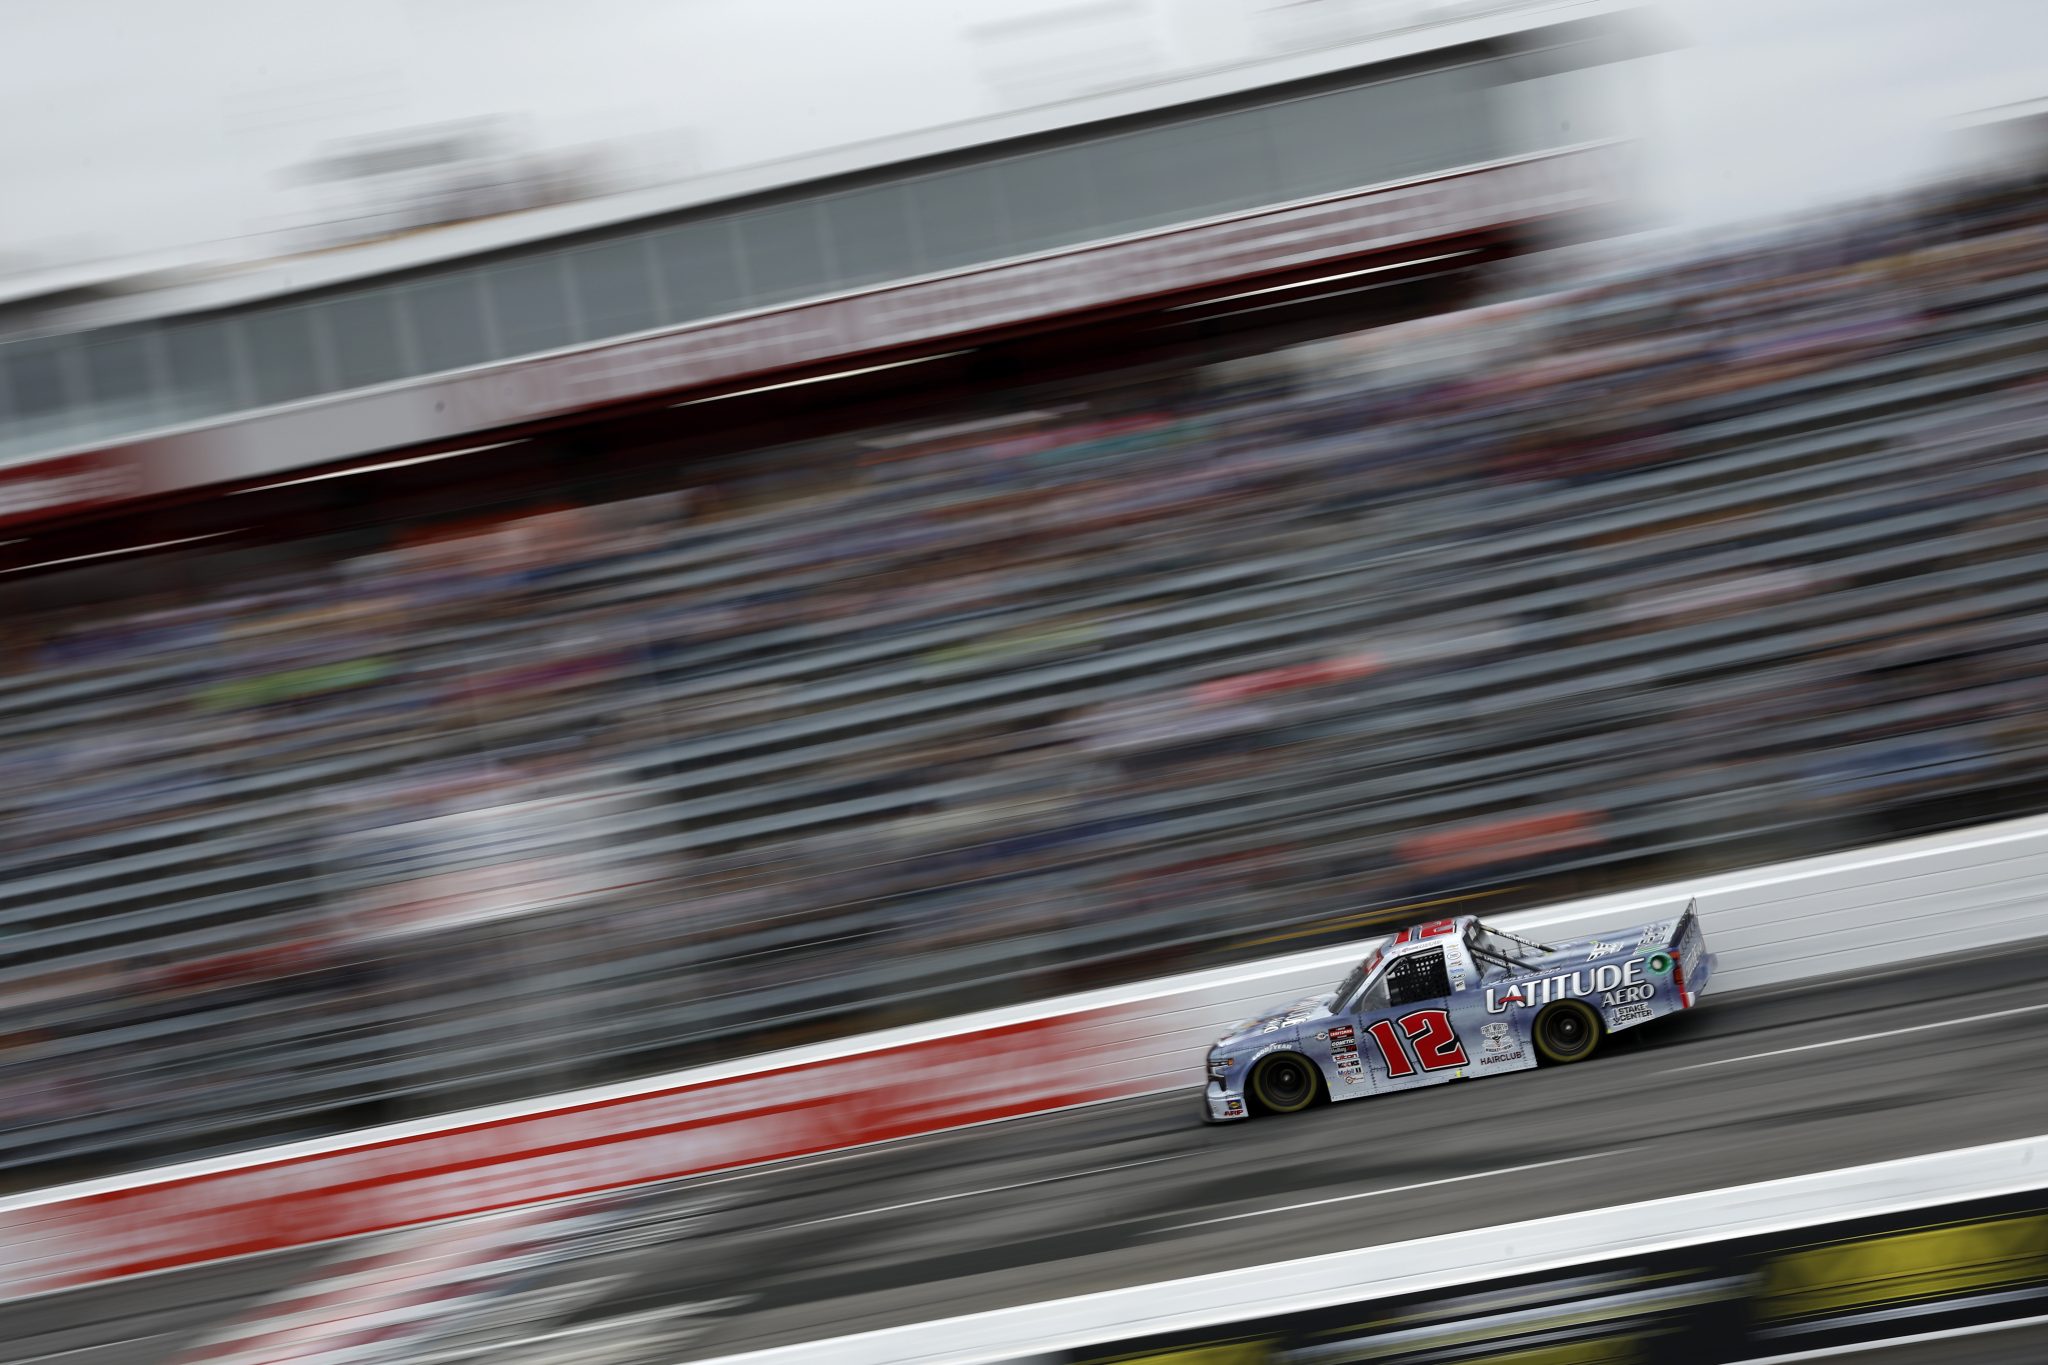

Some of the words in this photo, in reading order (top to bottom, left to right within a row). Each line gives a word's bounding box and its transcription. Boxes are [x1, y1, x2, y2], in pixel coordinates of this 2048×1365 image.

[1486, 957, 1646, 1014] LATITUDE
[1601, 983, 1655, 1008] AERO
[1618, 1003, 1645, 1014] STAKE
[1619, 1009, 1652, 1022] CENTER
[1330, 1029, 1352, 1037] CRAFTSMAN
[1366, 1009, 1469, 1078] 12
[1252, 1043, 1293, 1061] GOODYEAR
[1480, 1051, 1522, 1065] HAIRCLUB
[1338, 1068, 1354, 1077] Mobil
[1224, 1109, 1244, 1117] ARP
